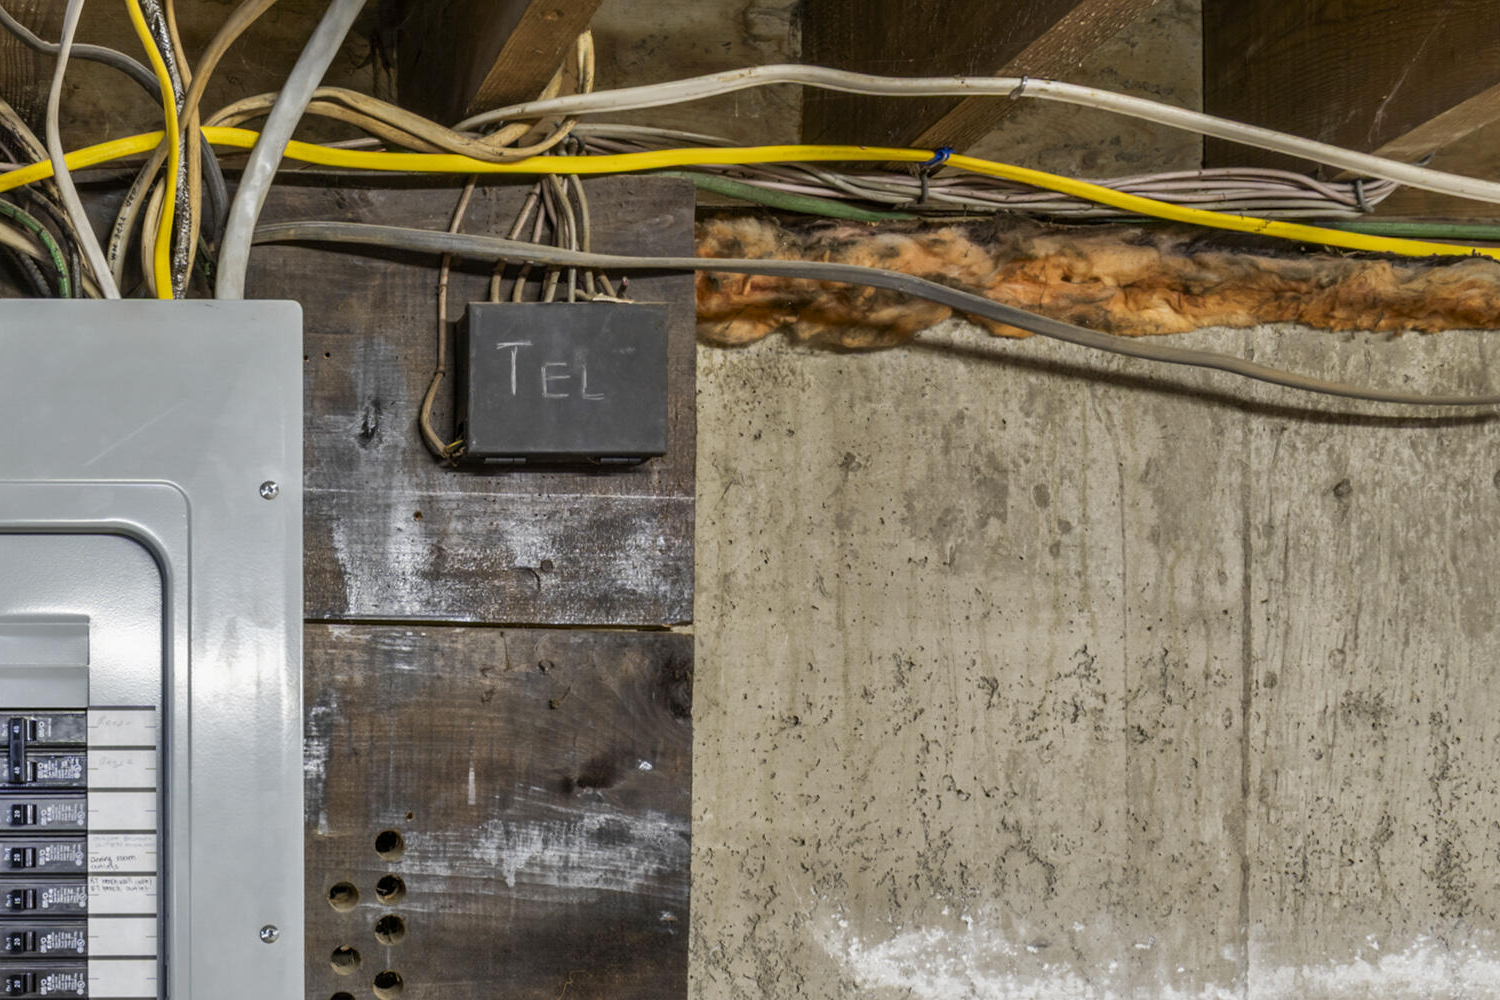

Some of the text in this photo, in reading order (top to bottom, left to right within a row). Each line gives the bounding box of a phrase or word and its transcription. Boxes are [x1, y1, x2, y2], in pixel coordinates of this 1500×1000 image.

[495, 339, 605, 400] TEL
[14, 810, 20, 818] 20
[14, 854, 20, 862] 20
[14, 938, 20, 946] 20
